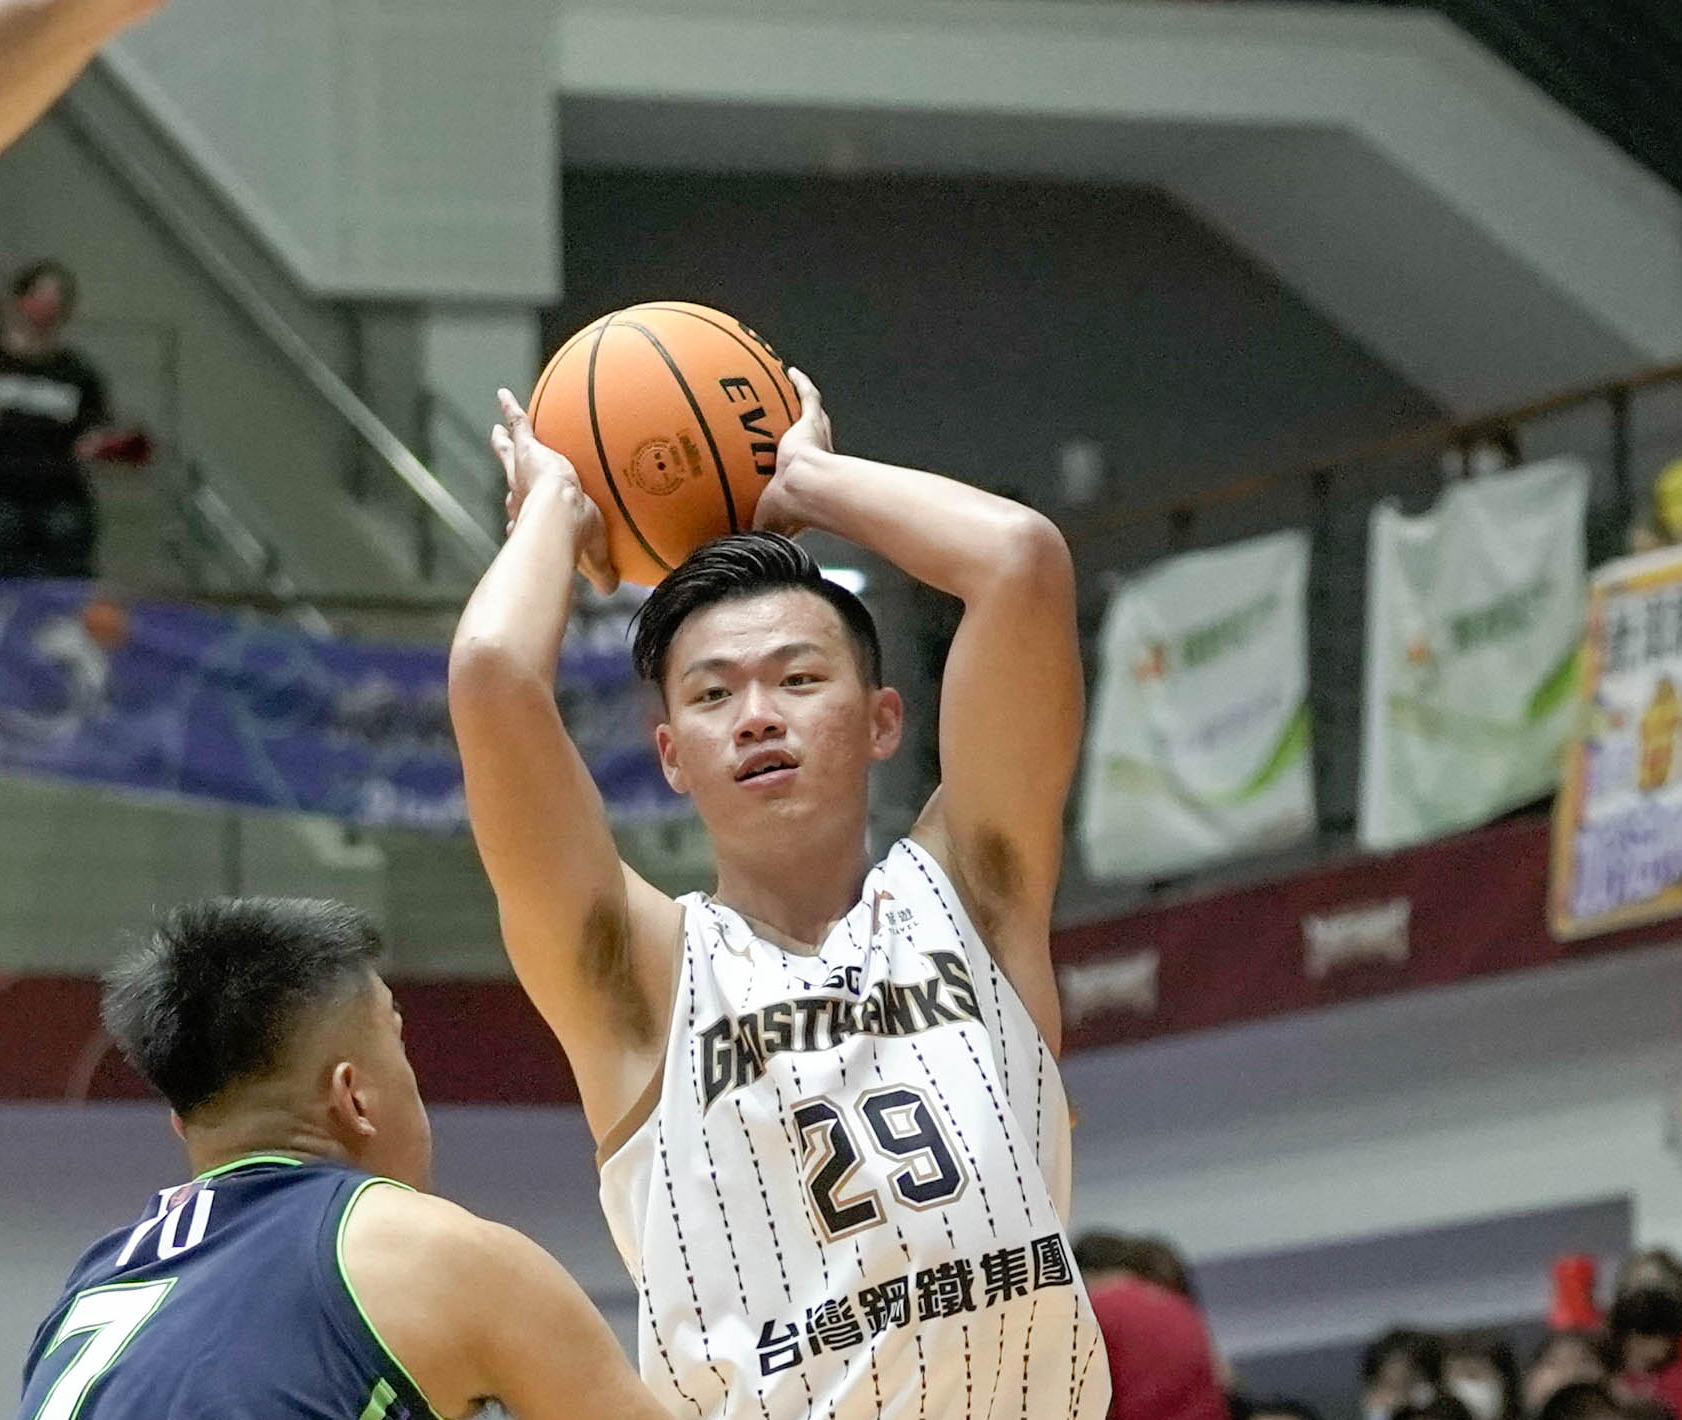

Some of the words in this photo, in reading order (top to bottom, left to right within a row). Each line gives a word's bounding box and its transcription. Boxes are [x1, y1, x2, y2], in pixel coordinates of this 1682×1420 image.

[789, 1083, 971, 1244] 29
[755, 1233, 1076, 1377] 台灣鋼鐵集團
